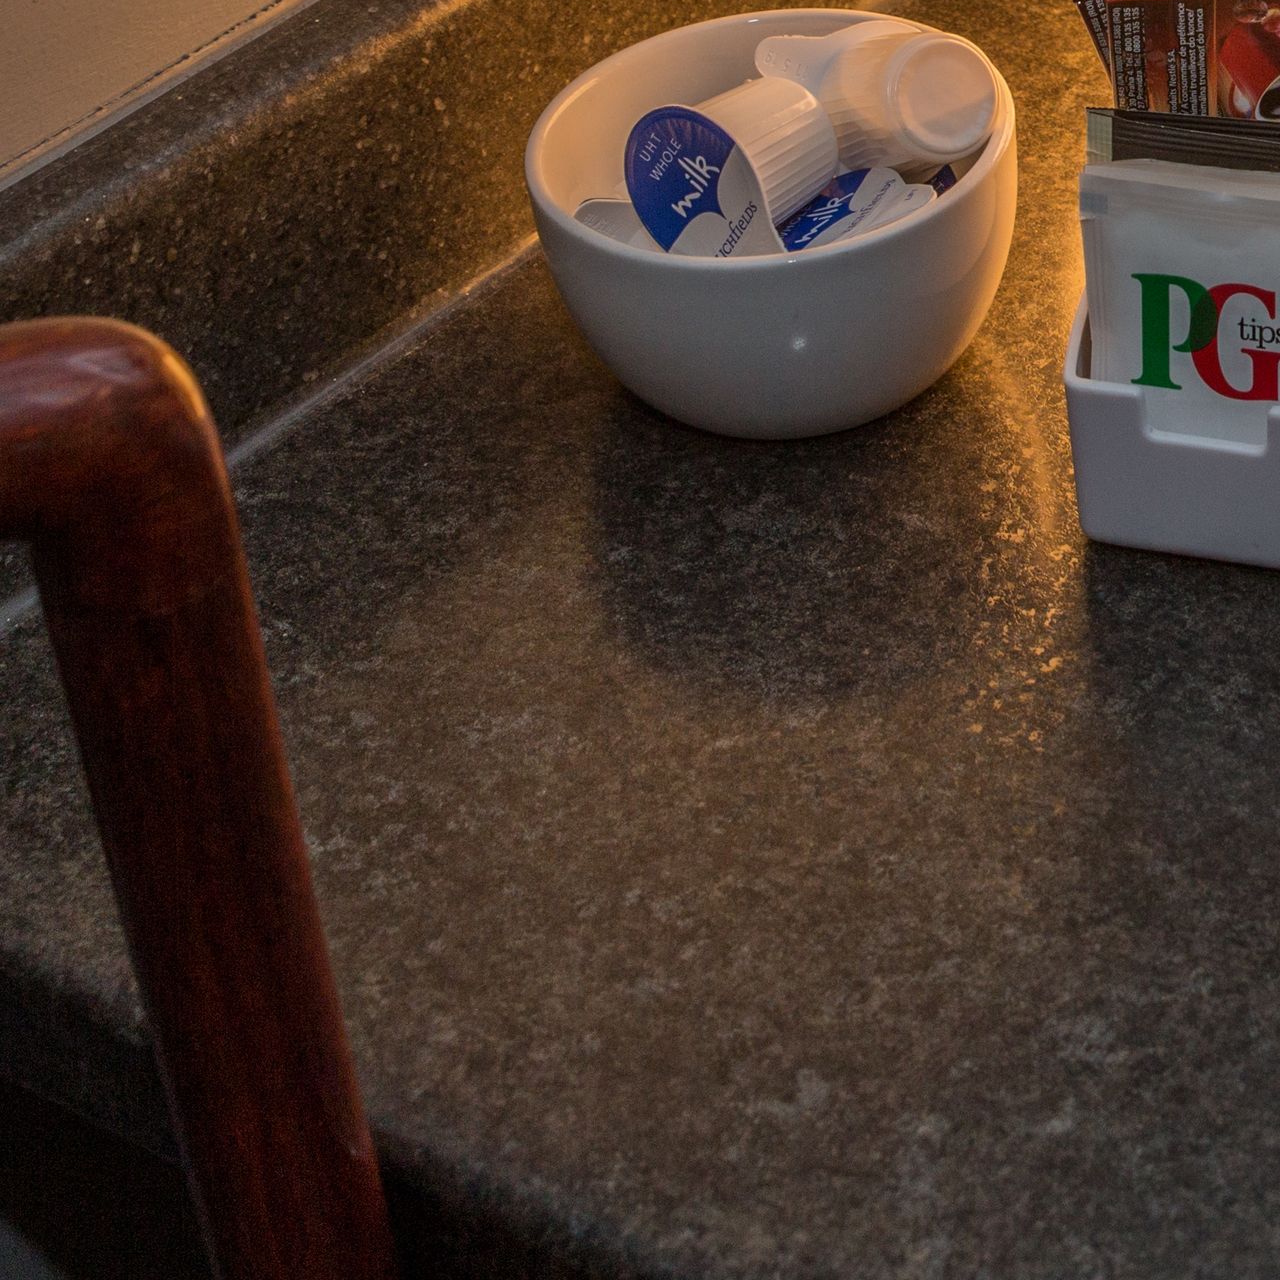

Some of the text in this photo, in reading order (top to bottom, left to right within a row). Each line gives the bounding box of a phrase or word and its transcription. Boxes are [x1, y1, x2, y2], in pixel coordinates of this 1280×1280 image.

[1123, 7, 1131, 20] 135
[1131, 6, 1141, 52] 0800 135 135
[1176, 2, 1189, 45] préférence
[1195, 8, 1204, 43] do konca
[1124, 37, 1132, 51] 800
[1179, 46, 1186, 56] de
[1185, 8, 1197, 88] trvanlivost do konce/
[1127, 76, 1135, 96] Praha
[1167, 48, 1176, 86] Nestlé S.A.
[1180, 57, 1189, 101] consommer
[638, 132, 662, 162] UHT
[648, 137, 681, 180] WHOLE
[671, 153, 720, 217] milk
[794, 192, 853, 242] milk
